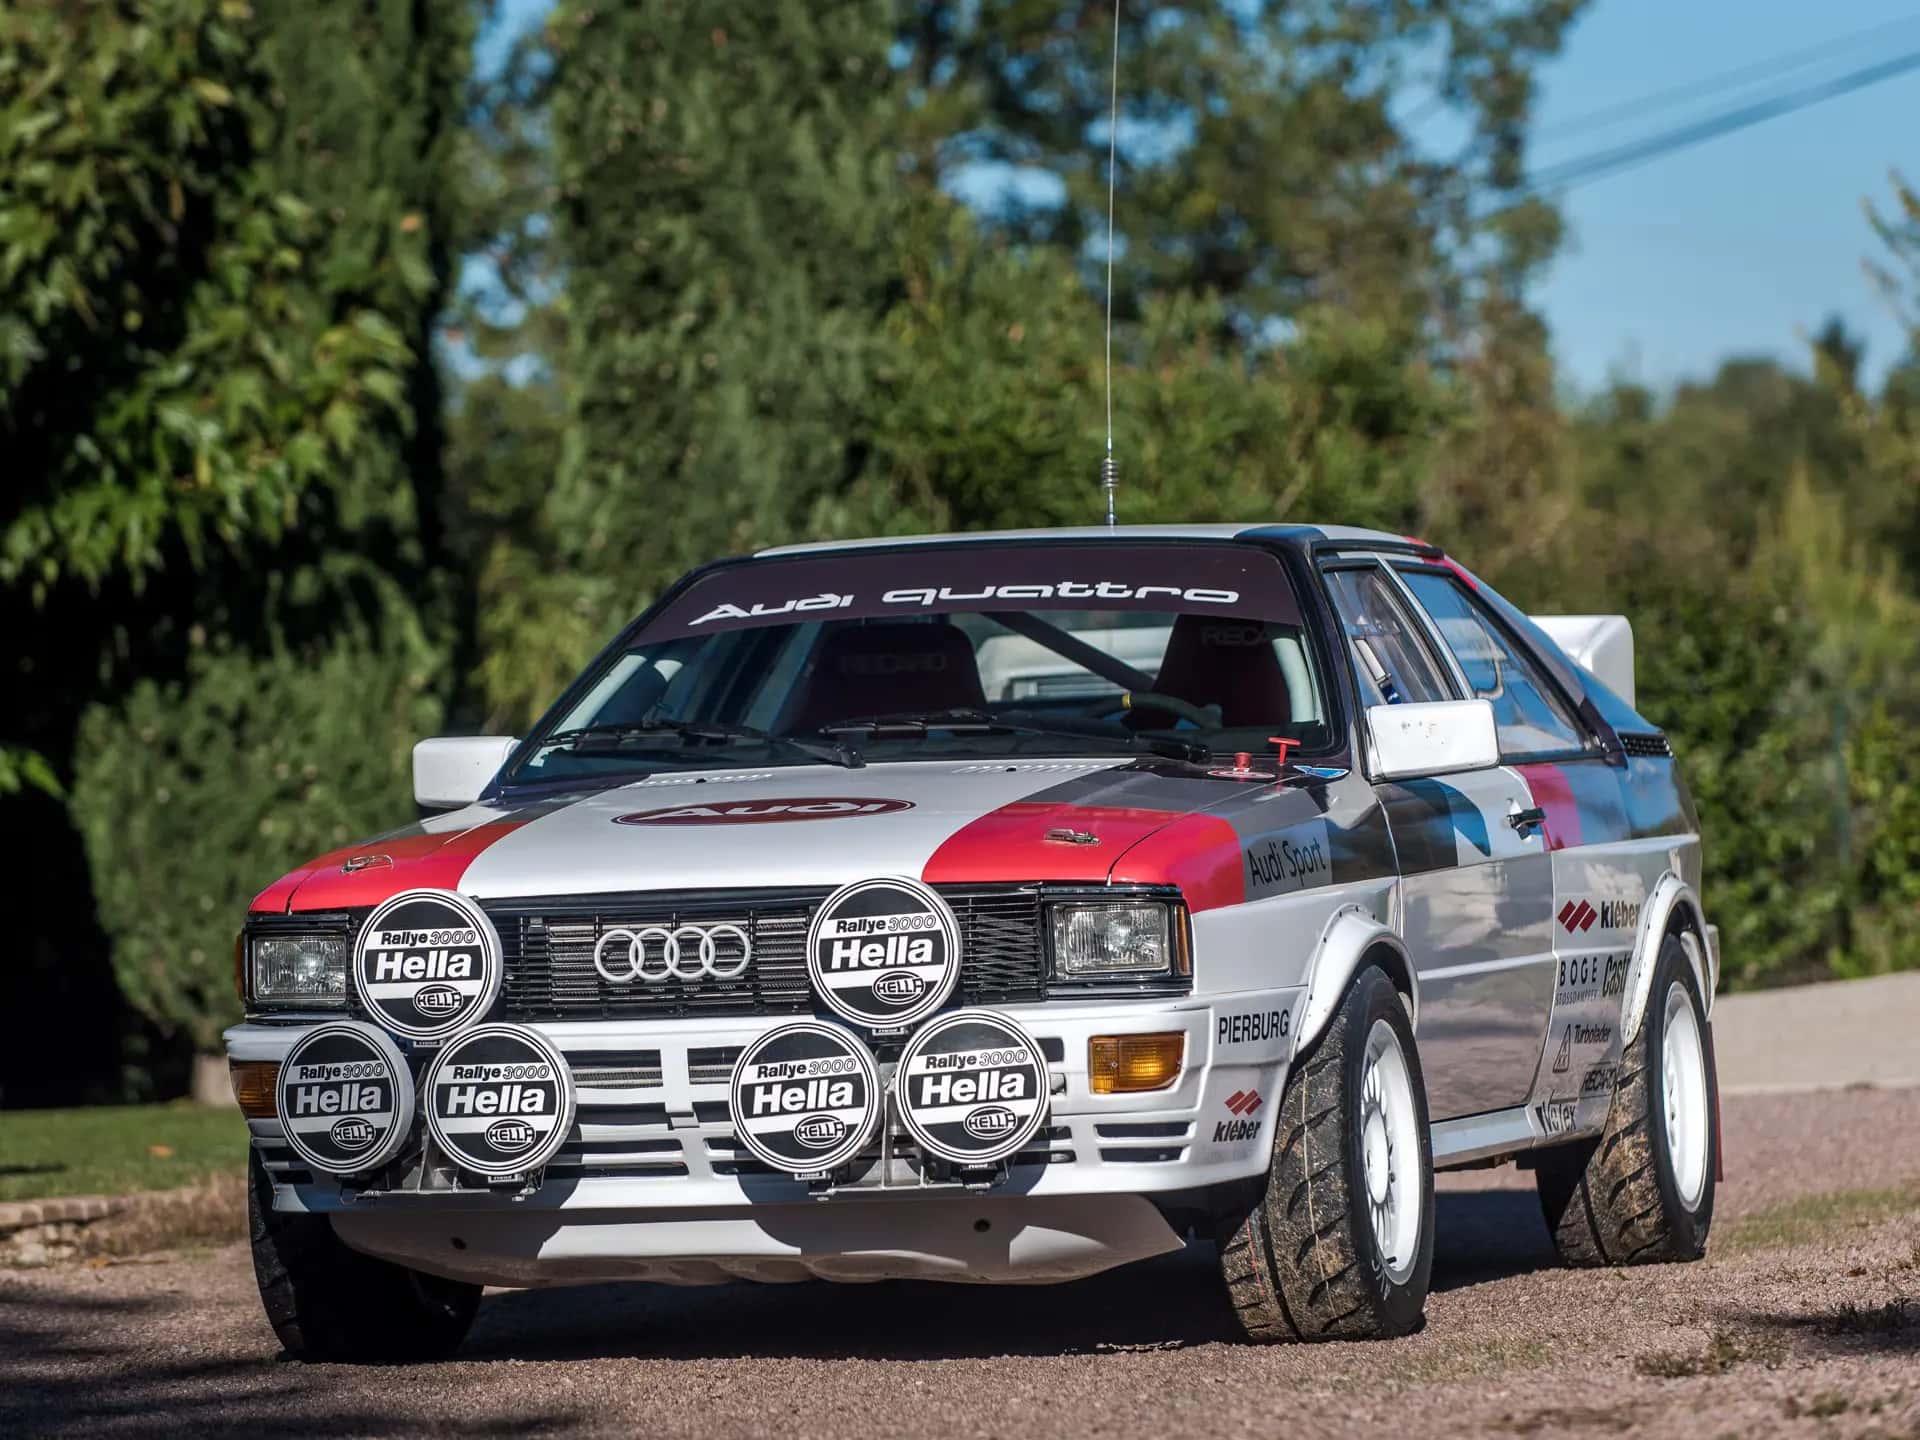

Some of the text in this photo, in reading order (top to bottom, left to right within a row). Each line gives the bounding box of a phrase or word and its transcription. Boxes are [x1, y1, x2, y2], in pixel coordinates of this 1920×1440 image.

[688, 582, 1239, 625] Audi quattro
[1247, 836, 1327, 887] Audi Sport
[836, 915, 937, 934] Rallye 3000
[381, 930, 476, 947] Rallye 3000
[831, 937, 934, 969] Hella
[375, 950, 472, 981] Hella
[1559, 957, 1598, 987] BOGE
[877, 979, 924, 995] HELLA
[417, 994, 462, 1008] HELLA
[1218, 1009, 1290, 1045] PIERBURG
[300, 1062, 385, 1080] Rallye 3000
[757, 1058, 857, 1079] Rallye 3000
[925, 1049, 1028, 1071] Rallye 3000
[453, 1064, 549, 1080] Rallye 3000
[296, 1085, 382, 1114] Hella
[446, 1085, 545, 1114] Hella
[752, 1082, 854, 1115] Hella
[921, 1073, 1026, 1105] Hella
[798, 1123, 846, 1139] HELLA
[968, 1113, 1017, 1130] HELLA
[1213, 1119, 1262, 1143] kléber
[333, 1127, 375, 1141] HELLA
[487, 1128, 535, 1143] HELLA
